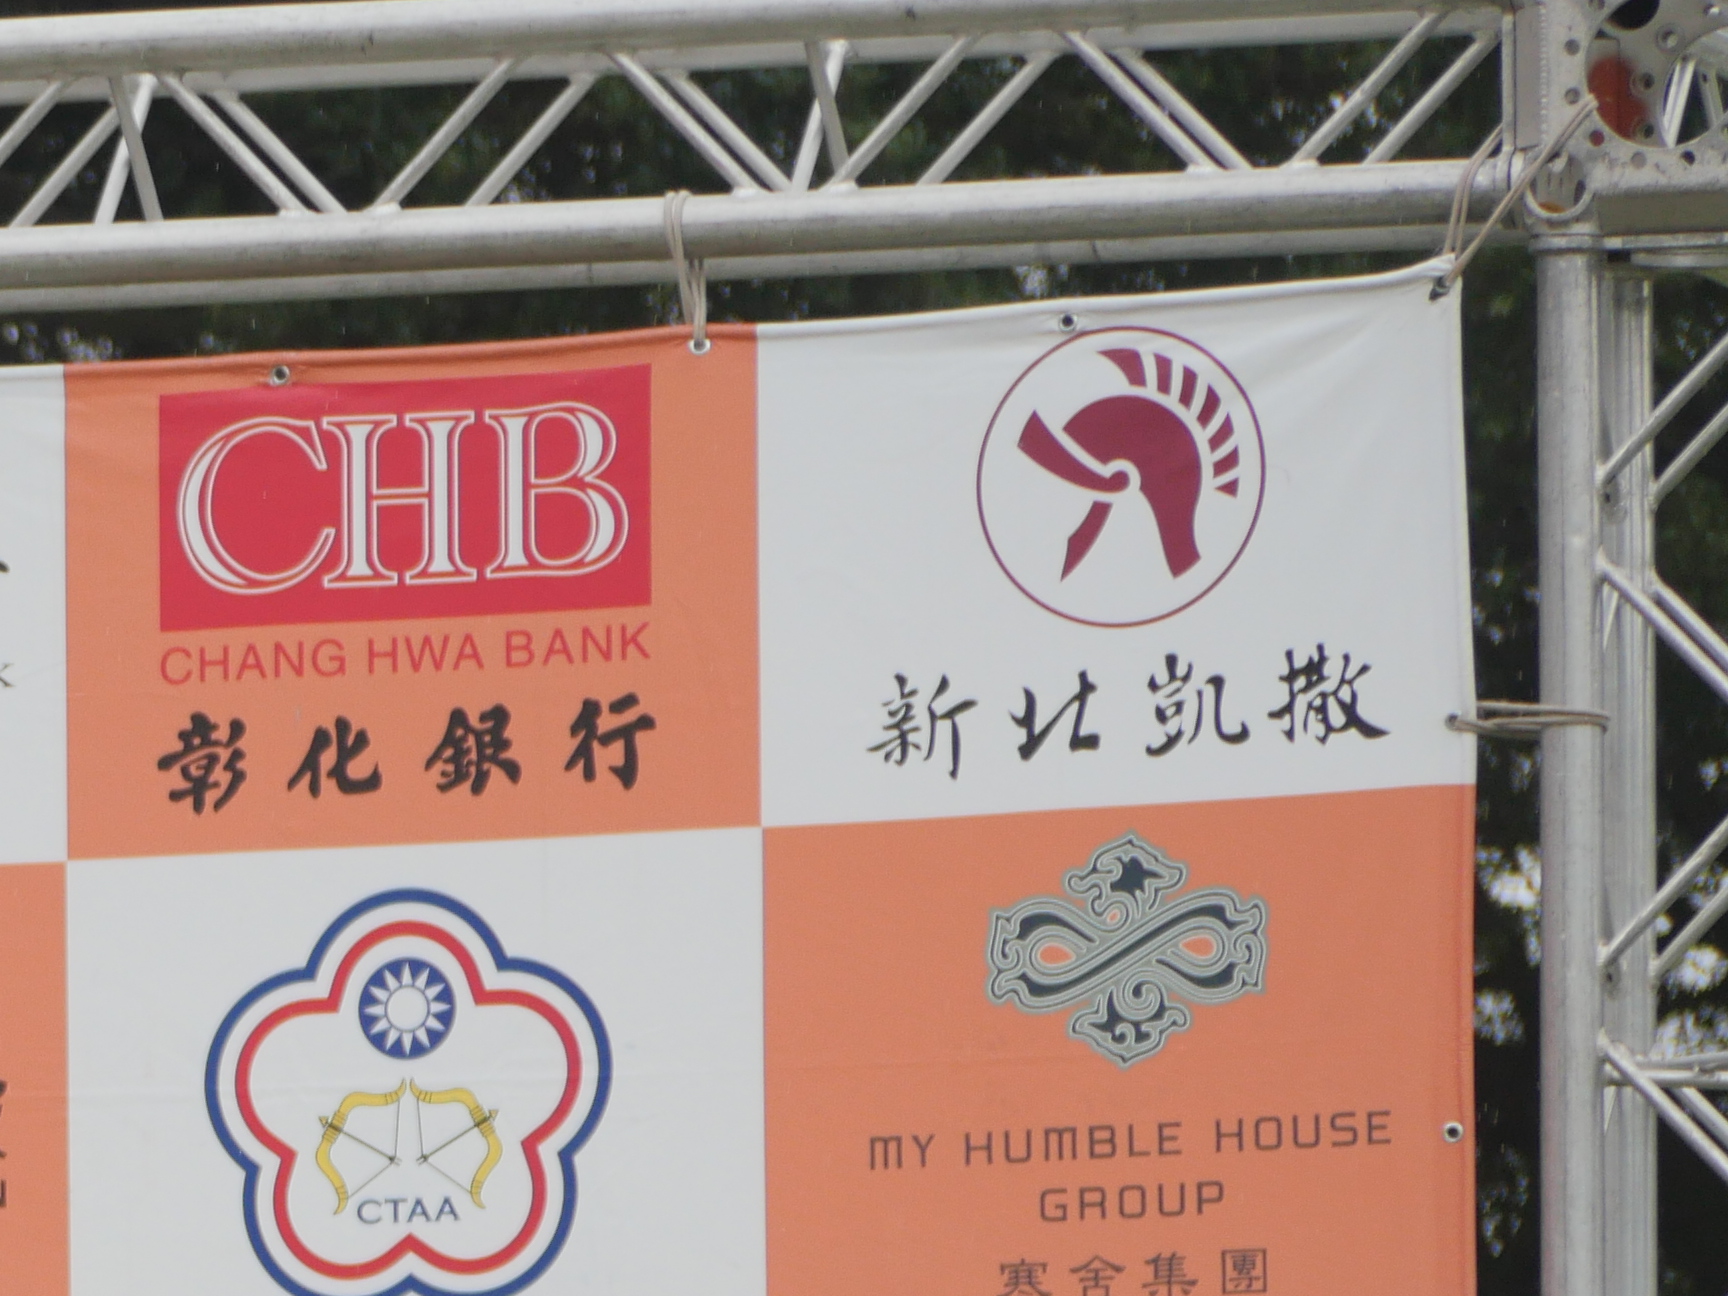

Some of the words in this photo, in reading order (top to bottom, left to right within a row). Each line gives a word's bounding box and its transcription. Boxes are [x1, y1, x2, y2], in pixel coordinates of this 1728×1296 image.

[175, 402, 630, 595] CHB
[160, 639, 347, 685] CHANG
[367, 633, 485, 674] HWA
[505, 622, 653, 668] BANK
[866, 644, 1391, 780] 新北凱撒
[156, 693, 657, 816] 彰化銀行
[869, 1135, 934, 1171] MY
[965, 1122, 1183, 1167] HUMBLE
[1215, 1110, 1392, 1154] HOUSE
[357, 1197, 460, 1226] CTAA
[1040, 1180, 1224, 1222] GROUP
